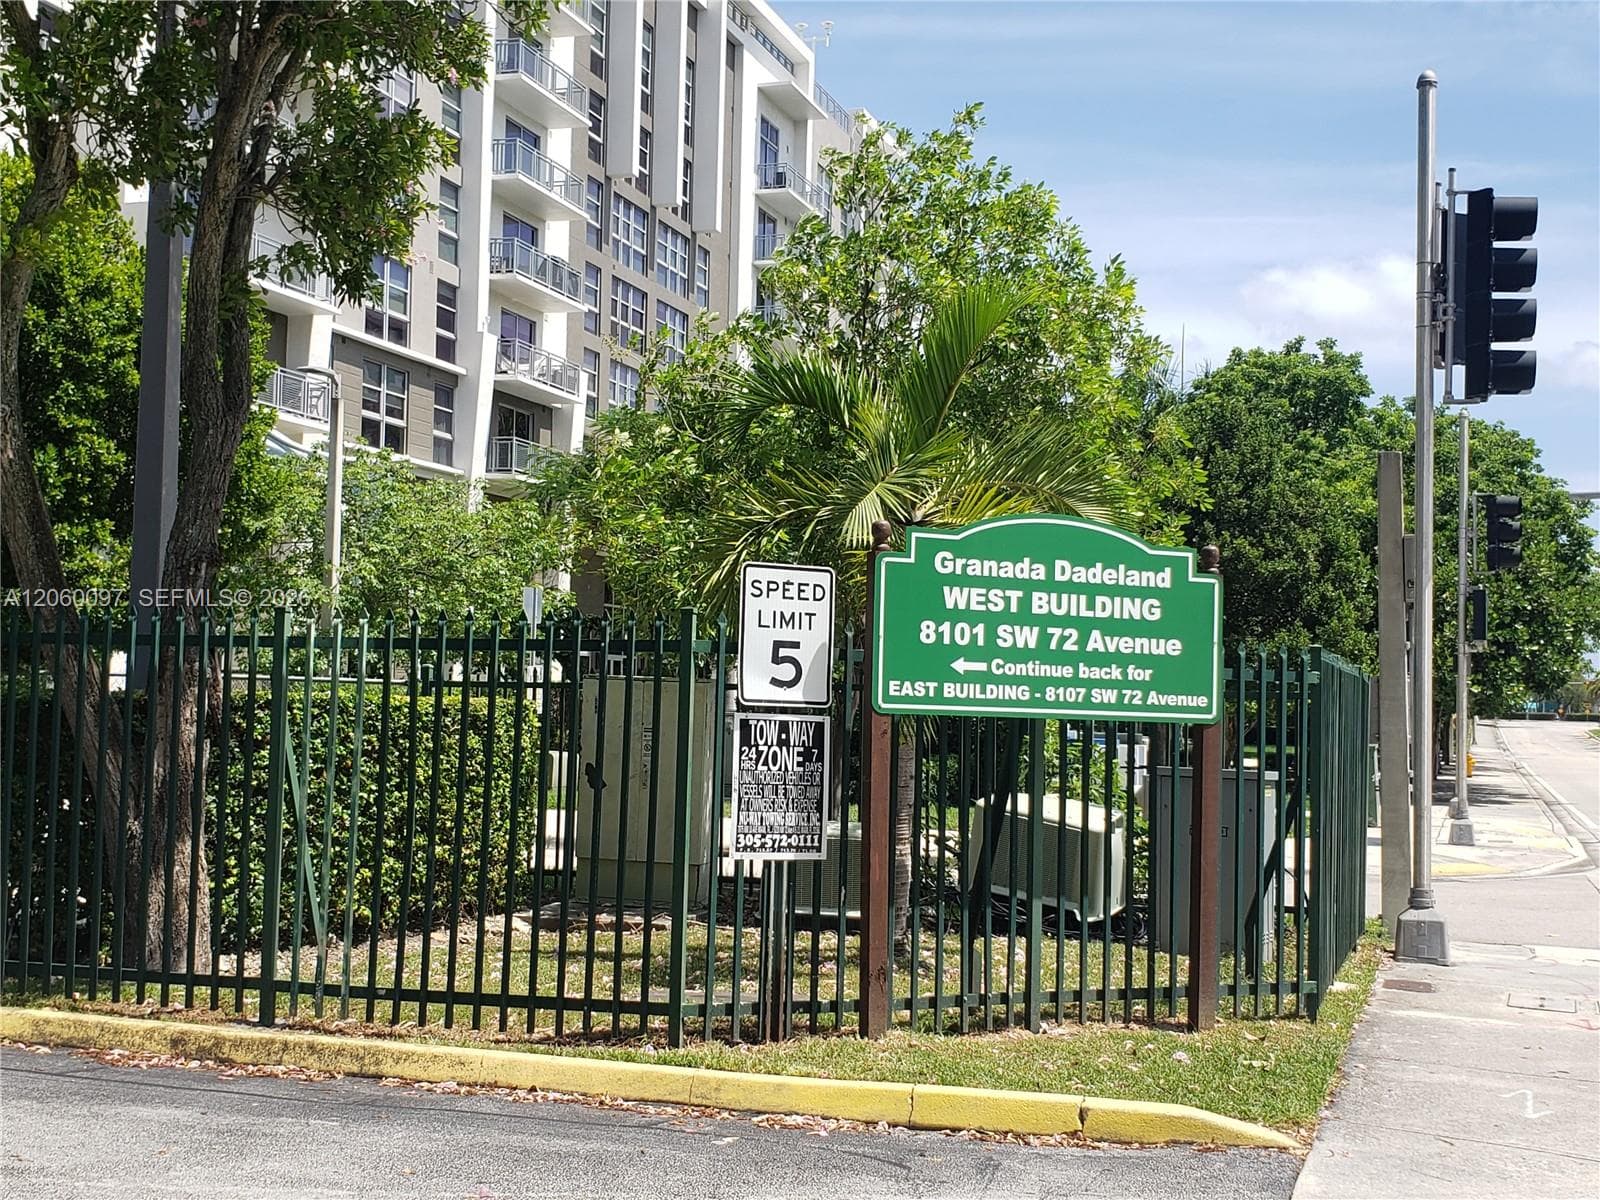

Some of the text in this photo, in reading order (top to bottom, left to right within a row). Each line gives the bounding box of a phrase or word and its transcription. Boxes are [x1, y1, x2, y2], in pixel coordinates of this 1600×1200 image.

[934, 551, 1171, 588] Granada Dadeland
[750, 579, 826, 601] SPEED
[943, 586, 1161, 621] WEST BUILDING
[758, 609, 816, 631] LIMIT
[919, 620, 1183, 656] 8101 SW 72 Avenue
[769, 640, 803, 689] 5
[990, 658, 1152, 681] Continue back for
[889, 680, 937, 697] EAST
[943, 682, 1030, 700] BUILDING
[1045, 688, 1085, 702] 8107
[1090, 689, 1118, 703] SW
[1122, 690, 1142, 704] 72
[1146, 692, 1208, 707] Avenue
[749, 720, 779, 745] TOW
[789, 721, 815, 747] WAY
[741, 747, 757, 759] 24
[757, 746, 804, 771] ZONE
[812, 749, 818, 761] 7
[741, 760, 756, 770] HRS
[805, 762, 822, 771] DAYS
[740, 771, 821, 785] UNAUTHORIZED VEHICLES OR
[740, 785, 821, 799] VESSELS WILL BE TOWED AWAY
[740, 799, 748, 811] AT
[749, 799, 773, 811] OWNERS
[774, 799, 787, 811] RISK
[794, 800, 817, 812] EXPENSE
[737, 834, 819, 847] 305-572-0111
